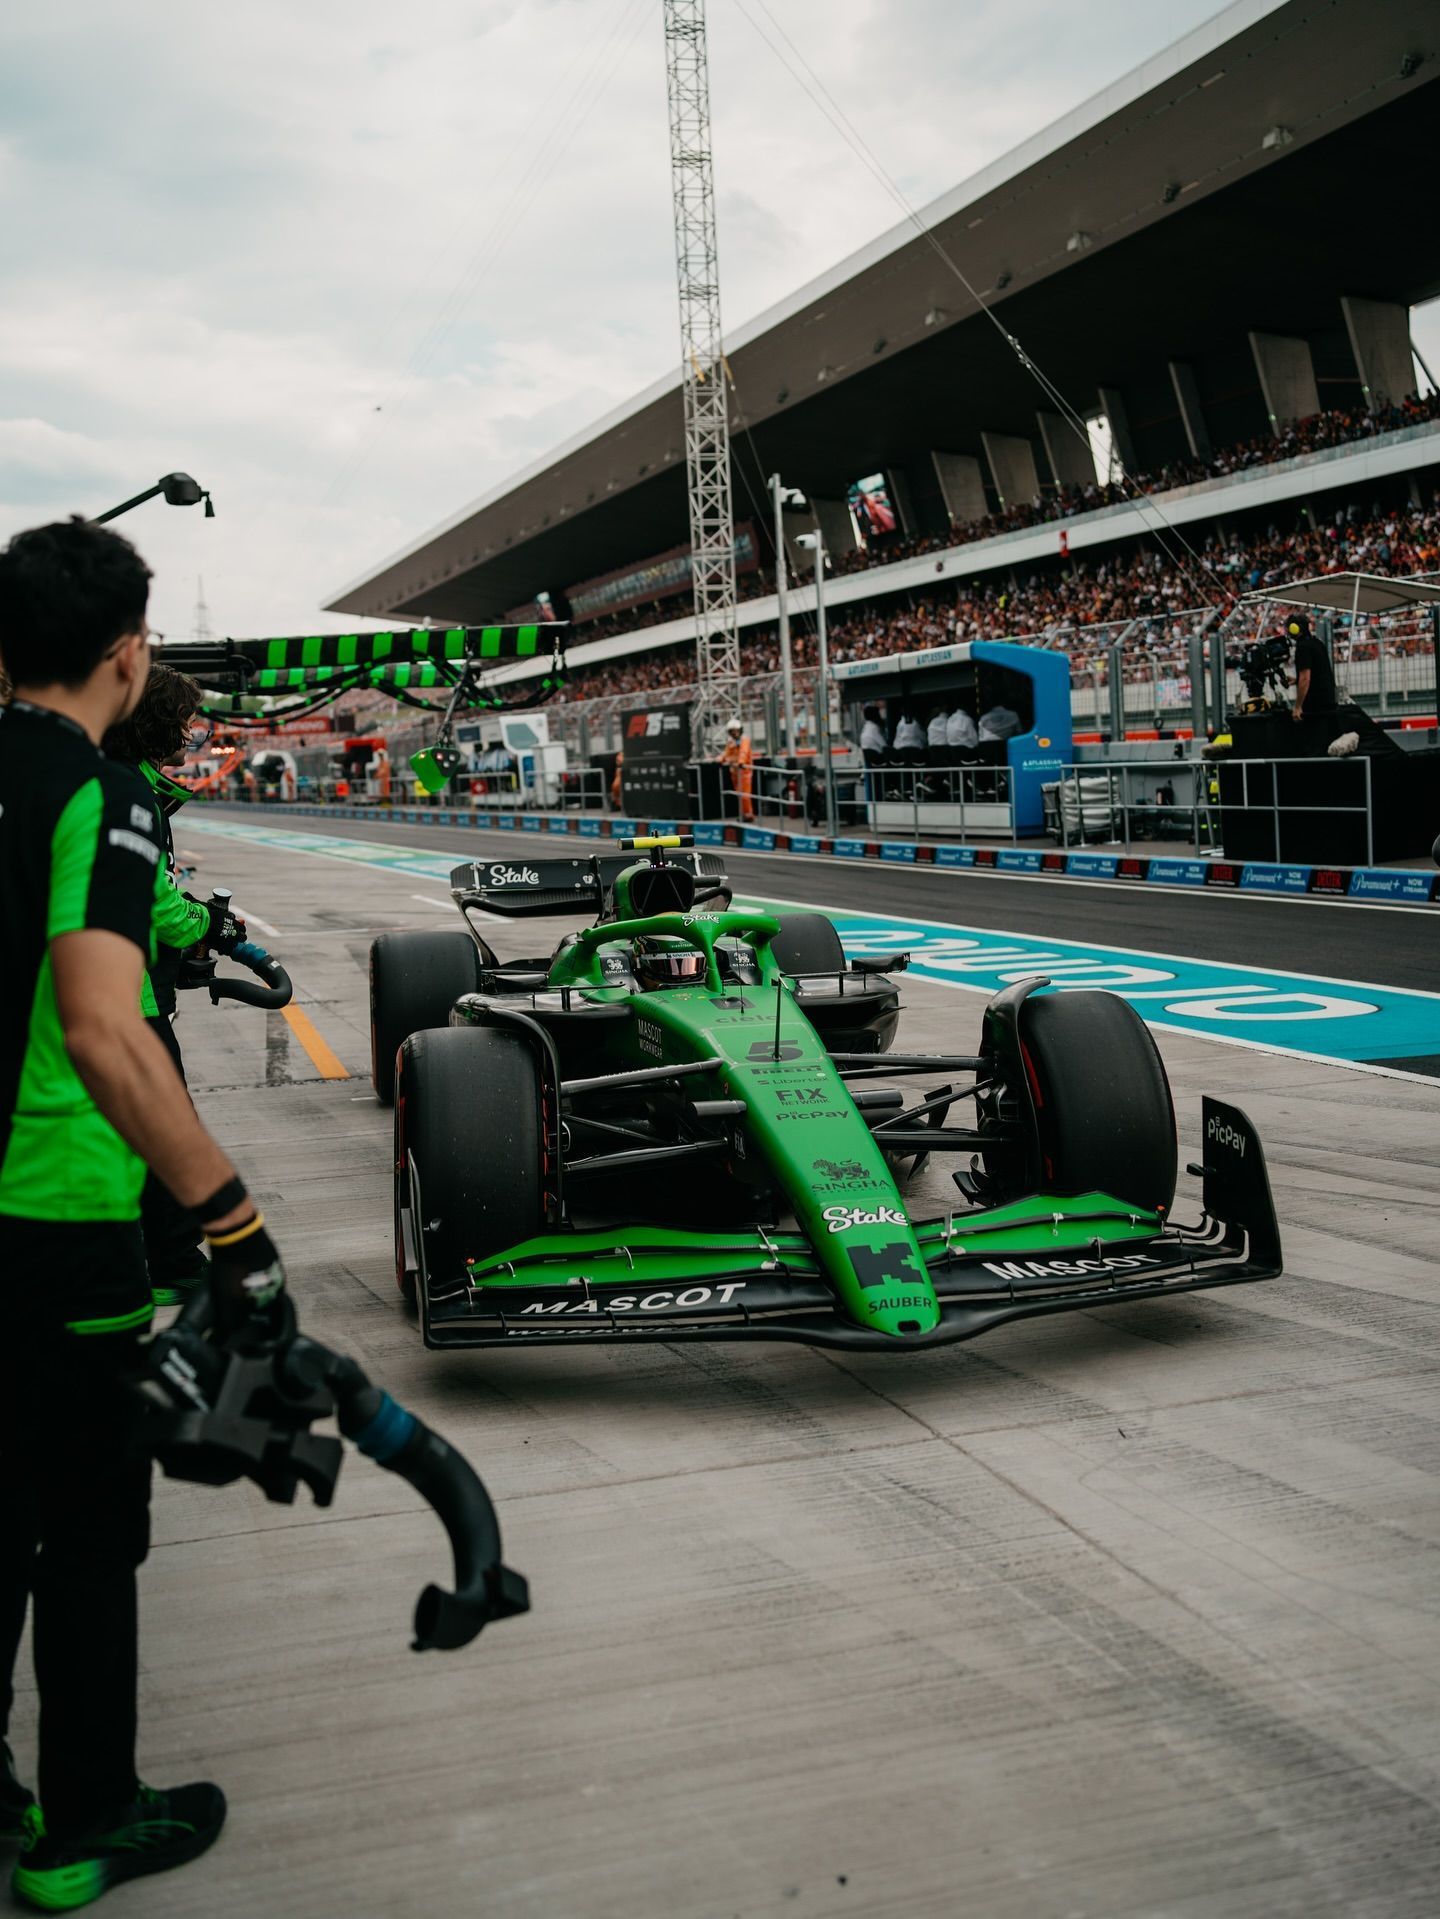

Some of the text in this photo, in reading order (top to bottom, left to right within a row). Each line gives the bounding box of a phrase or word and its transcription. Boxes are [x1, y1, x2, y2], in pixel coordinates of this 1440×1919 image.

[489, 864, 540, 886] Stake
[1352, 873, 1400, 892] Paramount+
[681, 914, 720, 927] Stake
[638, 1018, 662, 1045] MASCOT
[745, 1040, 803, 1062] 5
[775, 1087, 828, 1101] FIX
[781, 1098, 829, 1106] NETWORK
[776, 1111, 849, 1121] PicPay
[1208, 1116, 1246, 1158] PicPay
[811, 1179, 892, 1192] SINGHA
[822, 1206, 909, 1234] Stake
[982, 1254, 1162, 1280] MASCOT
[520, 1282, 747, 1314] MASCOT
[868, 1296, 933, 1315] SAUBER
